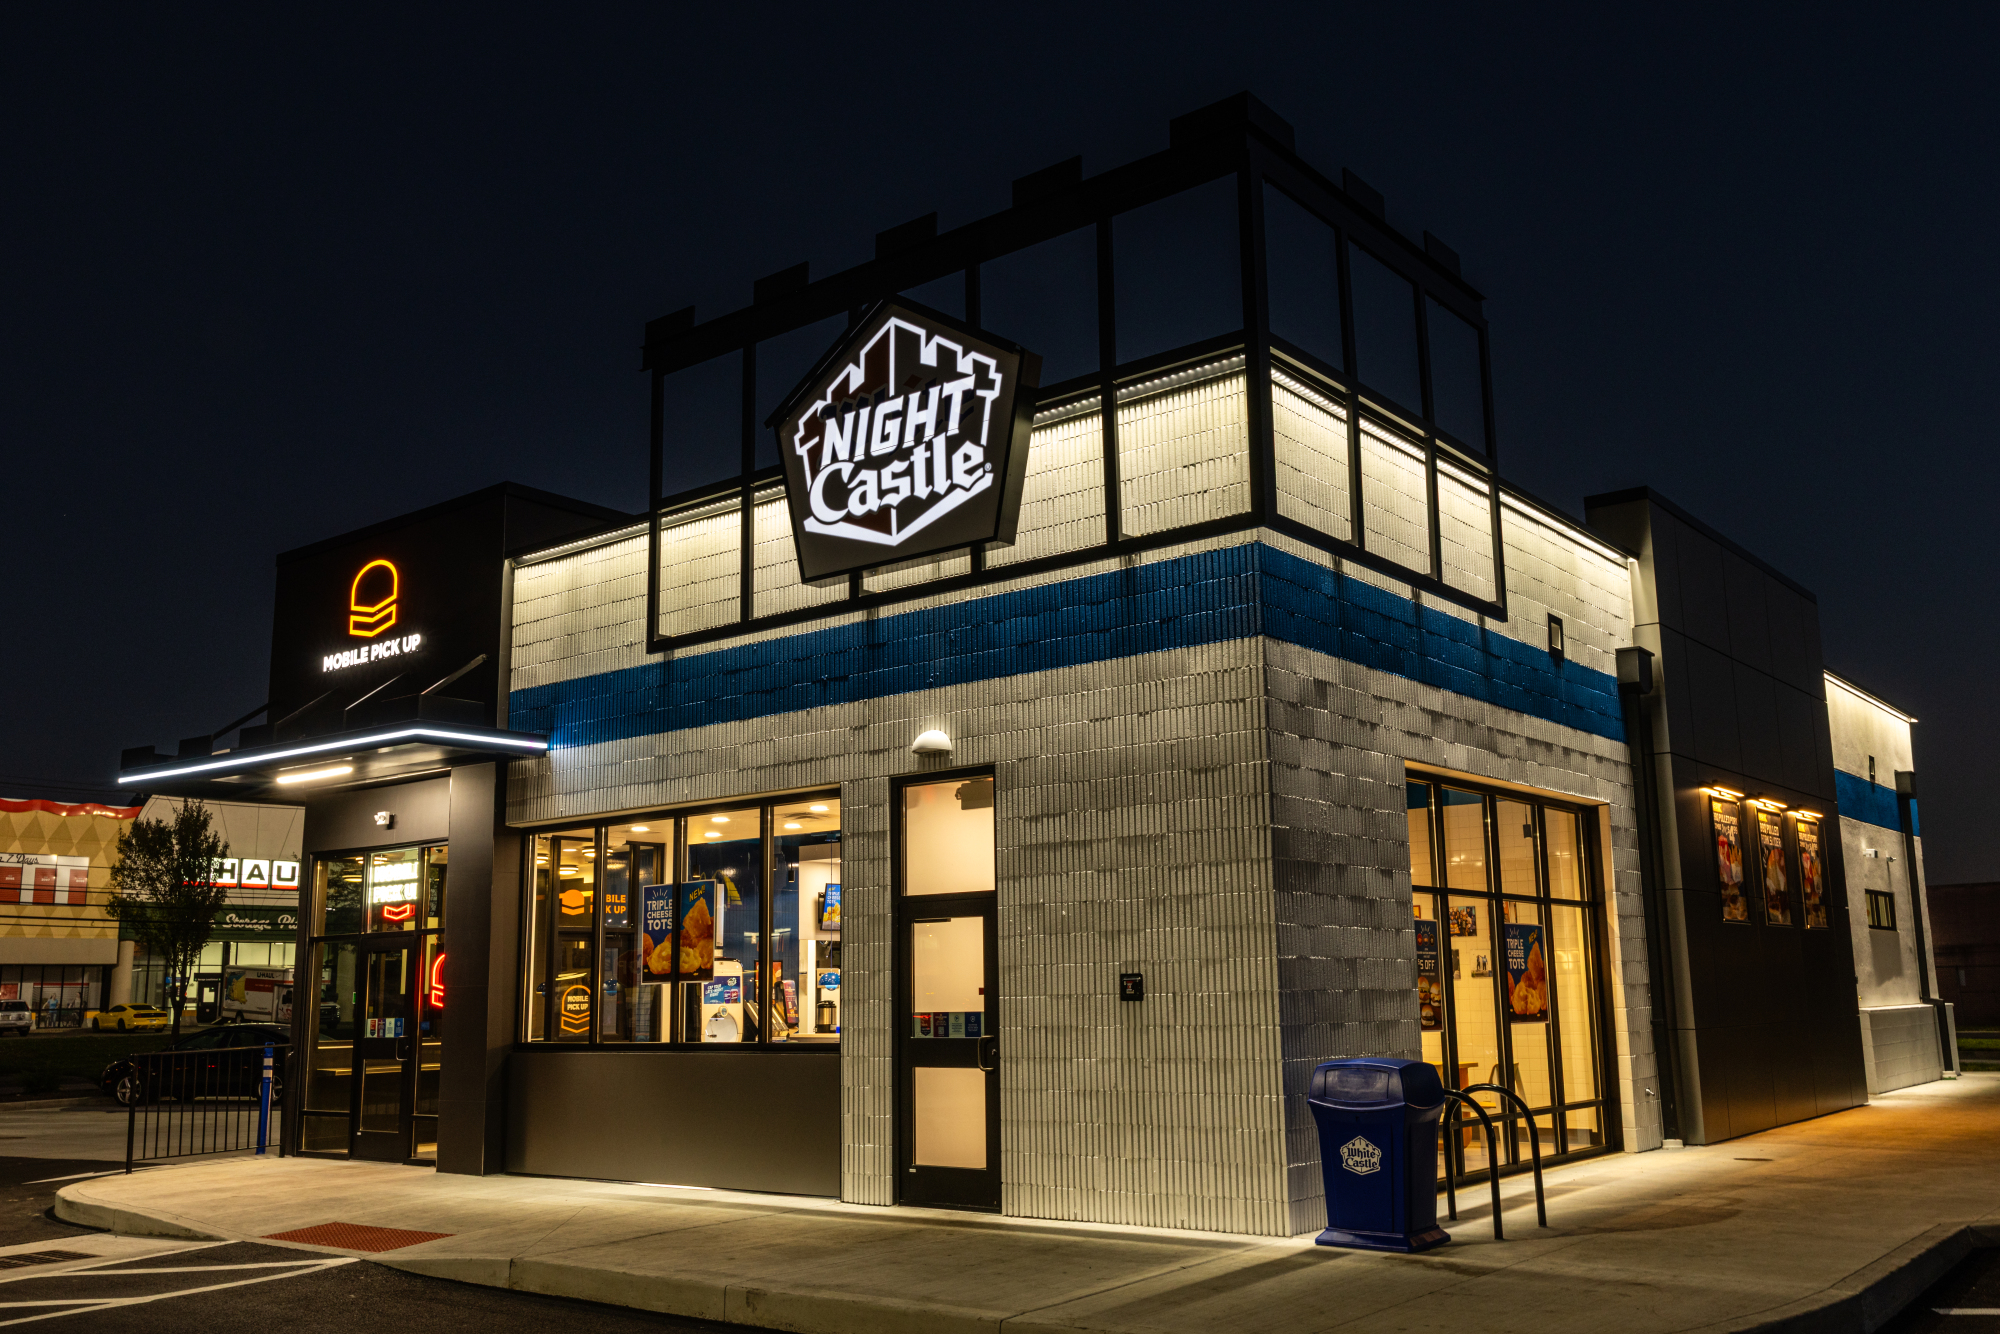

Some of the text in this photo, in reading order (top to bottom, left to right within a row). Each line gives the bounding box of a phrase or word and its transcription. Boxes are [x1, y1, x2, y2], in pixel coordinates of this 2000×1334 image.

[820, 373, 976, 469] NIGHT
[809, 431, 985, 524] Castle
[323, 633, 421, 672] MOBILE PICK UP
[16, 854, 39, 865] Days
[613, 905, 627, 914] UP
[647, 899, 673, 911] TRIPLE
[647, 910, 673, 919] CHEESE
[648, 918, 673, 931] TOTS
[1506, 938, 1524, 950] TRIPLE
[1507, 949, 1525, 958] CHEESE
[1508, 958, 1526, 970] TOTS
[567, 995, 589, 1003] MOBILE
[566, 1003, 580, 1011] PICK
[1347, 1147, 1376, 1159] White
[1345, 1157, 1378, 1169] Castle
